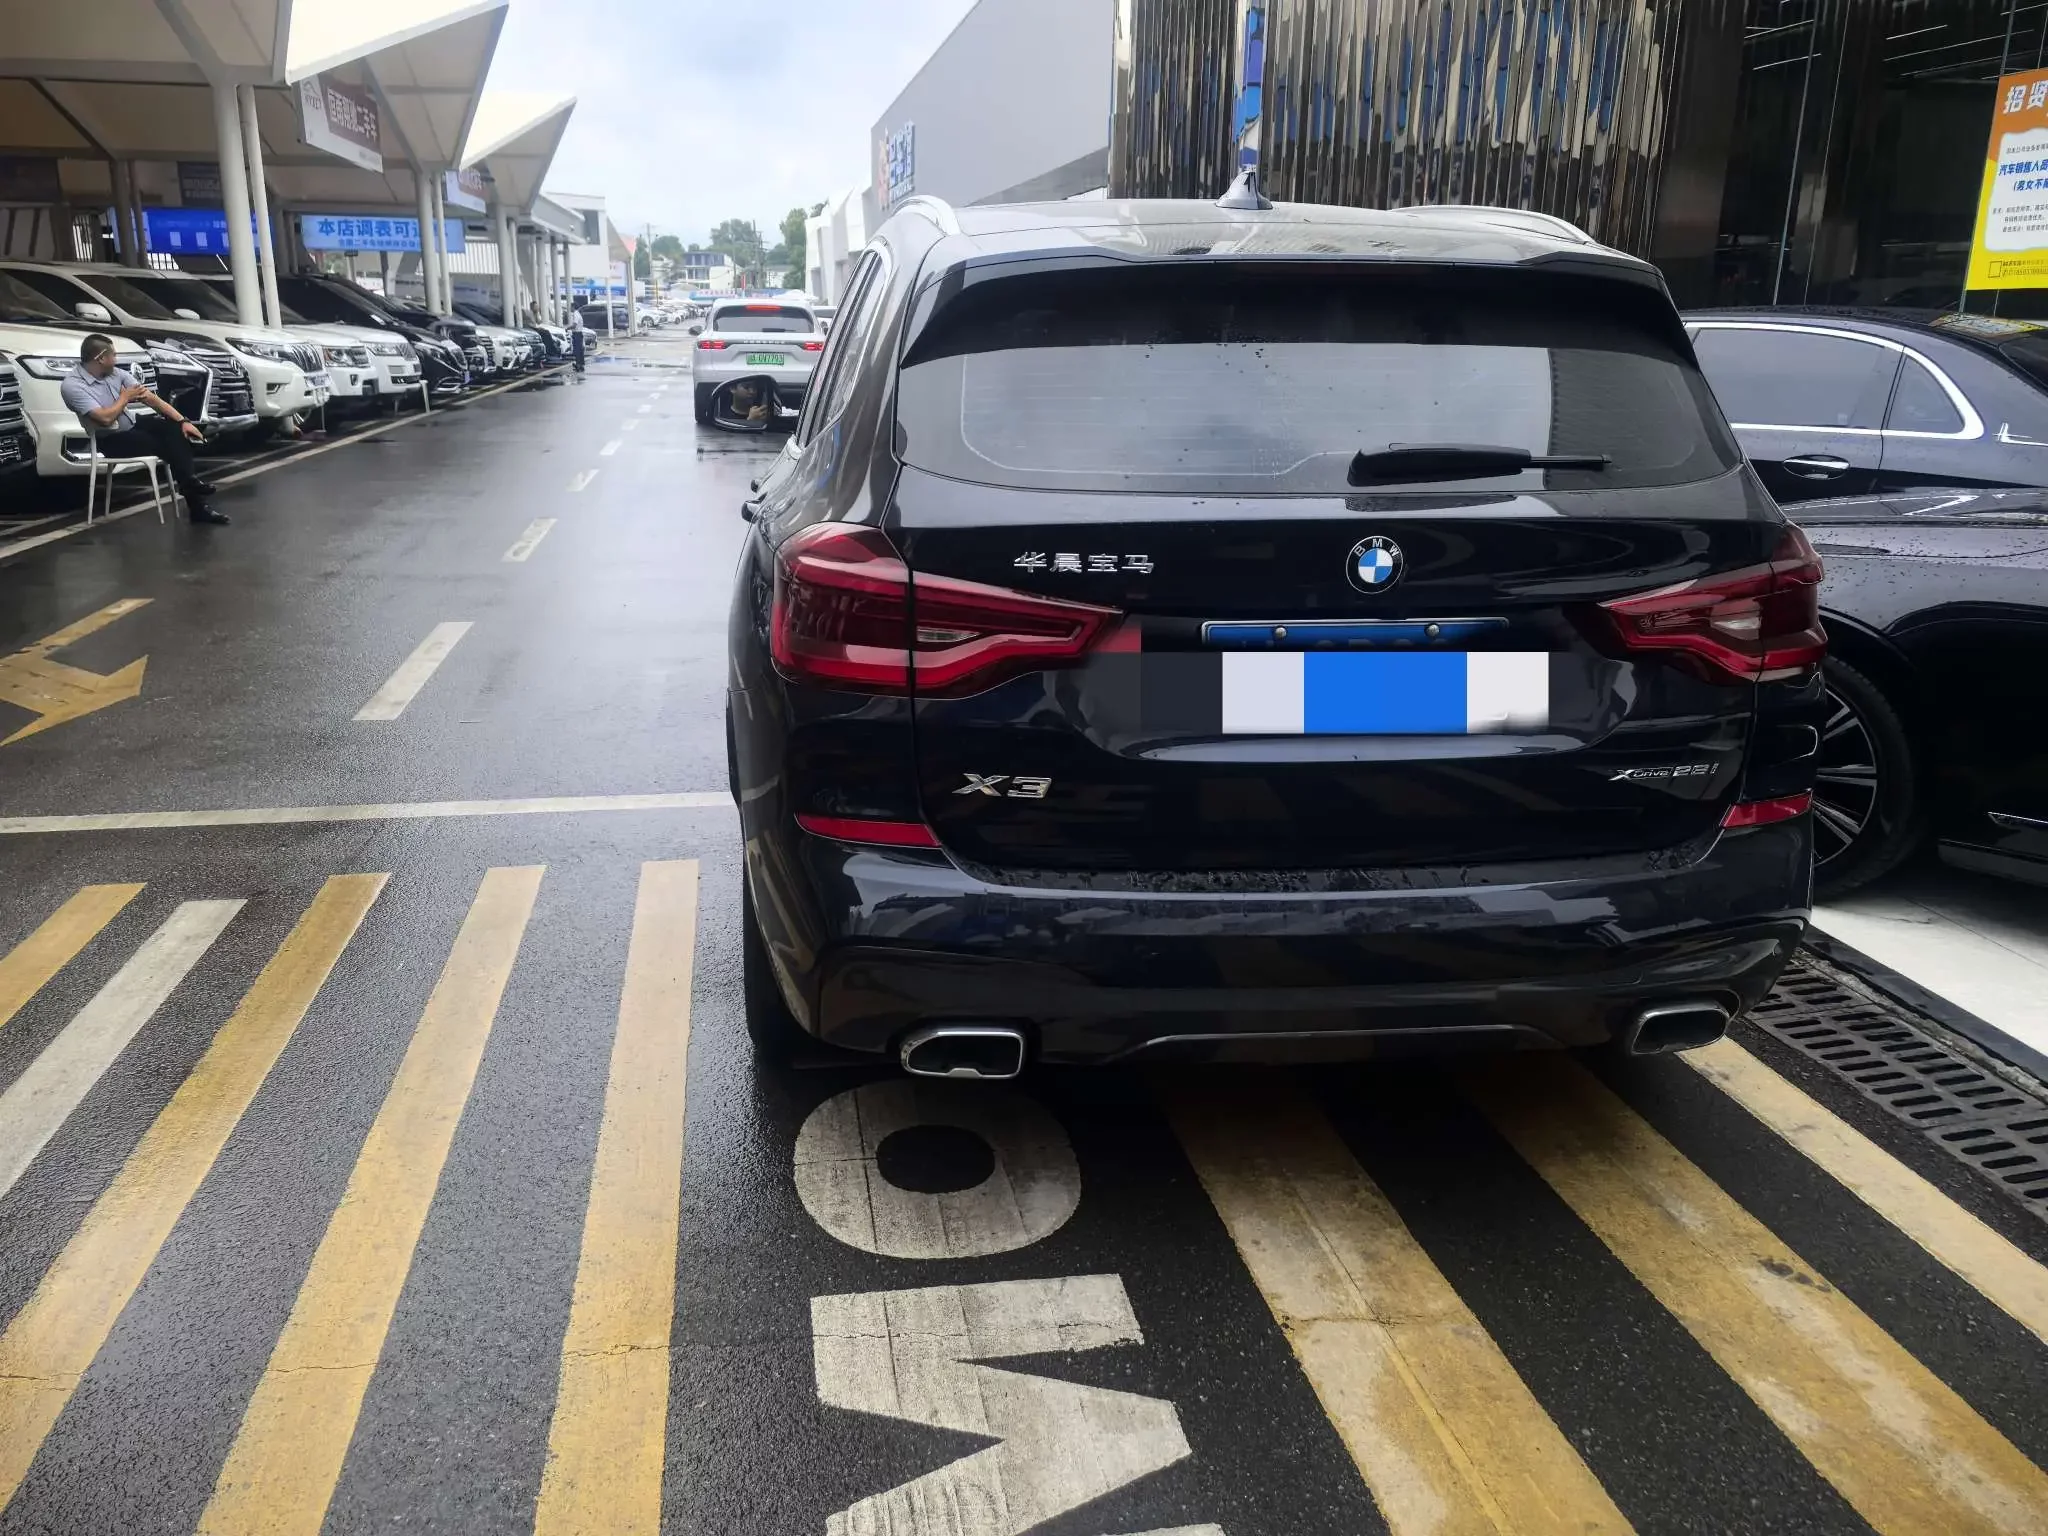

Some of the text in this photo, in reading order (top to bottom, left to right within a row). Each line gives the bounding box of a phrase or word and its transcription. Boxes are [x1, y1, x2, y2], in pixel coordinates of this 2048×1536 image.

[1354, 538, 1400, 557] BMW
[1013, 551, 1154, 574] 华晨宝马
[952, 772, 1052, 799] X3
